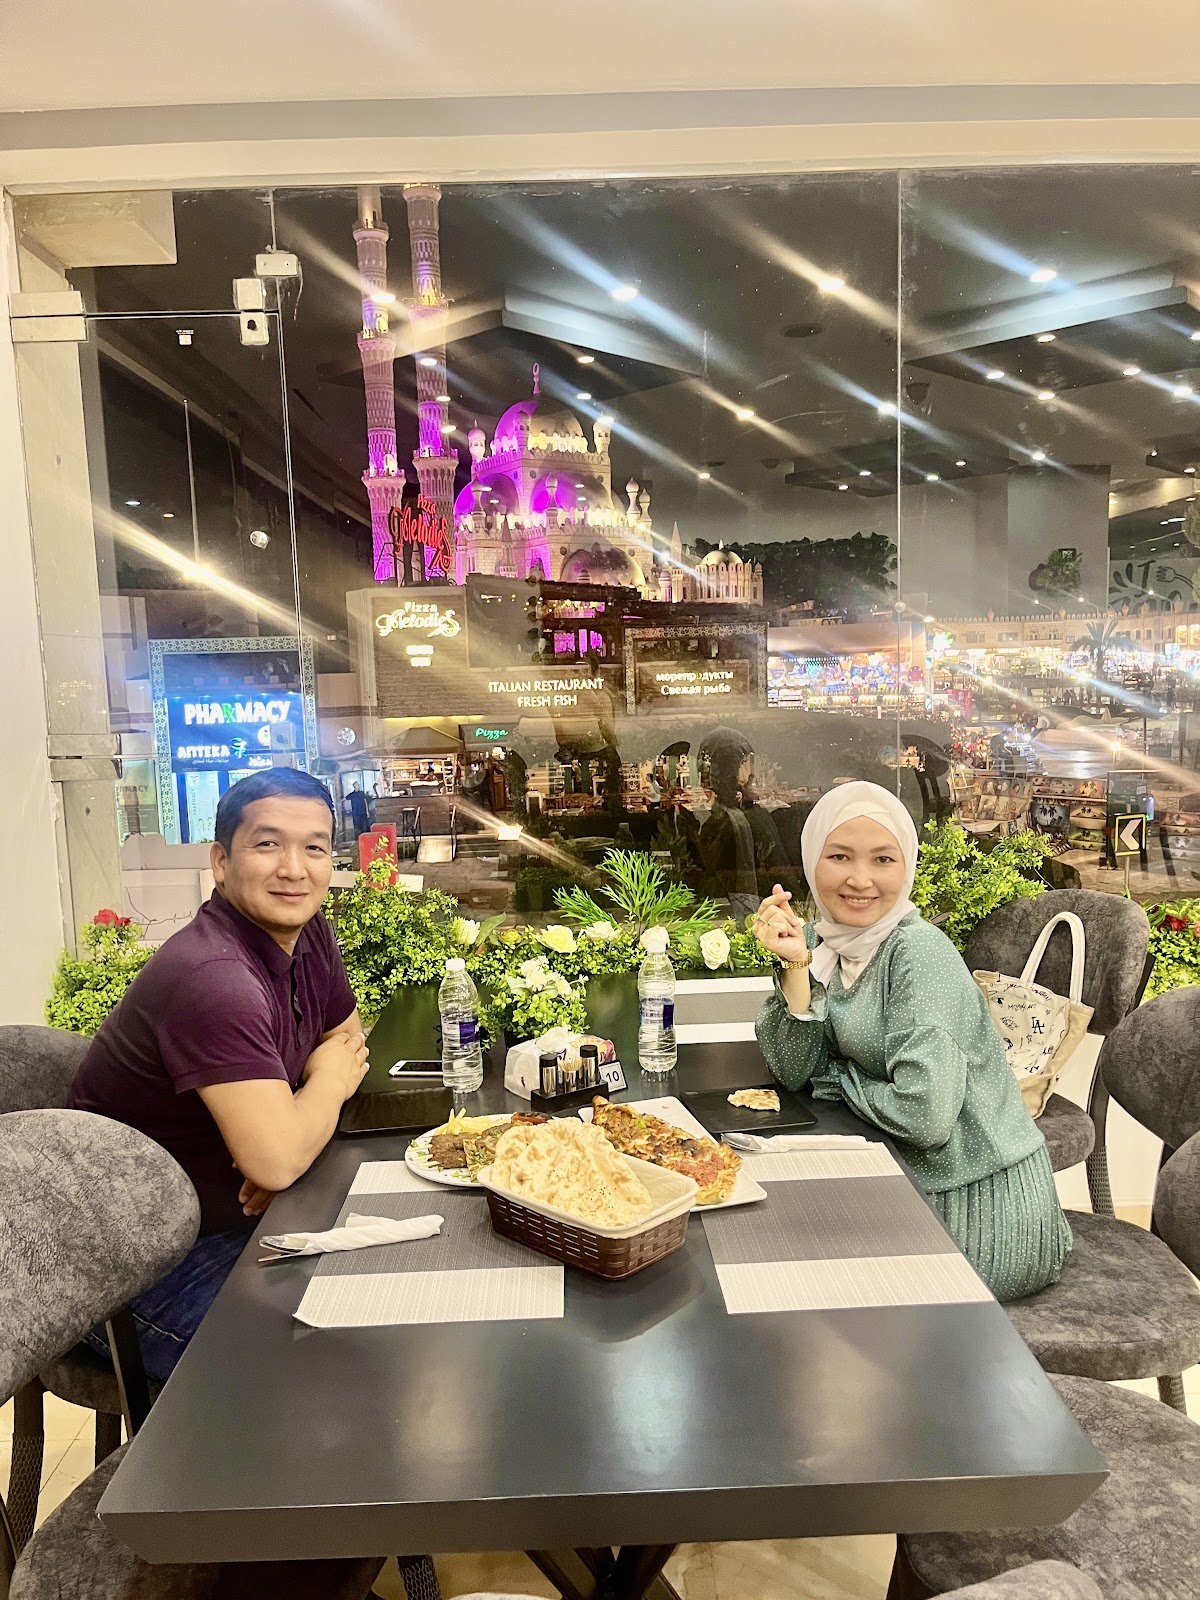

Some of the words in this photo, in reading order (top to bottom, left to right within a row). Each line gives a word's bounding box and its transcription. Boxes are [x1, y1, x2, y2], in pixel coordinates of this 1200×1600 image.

[404, 601, 438, 613] Pizza
[488, 681, 531, 693] ITALIAN
[534, 677, 605, 692] RESTAURANT
[703, 683, 732, 696] рыба
[517, 696, 551, 708] FRESH
[553, 694, 578, 707] FISH
[184, 700, 291, 725] PHARMACY
[475, 728, 509, 740] Pizza
[605, 1070, 620, 1084] 10
